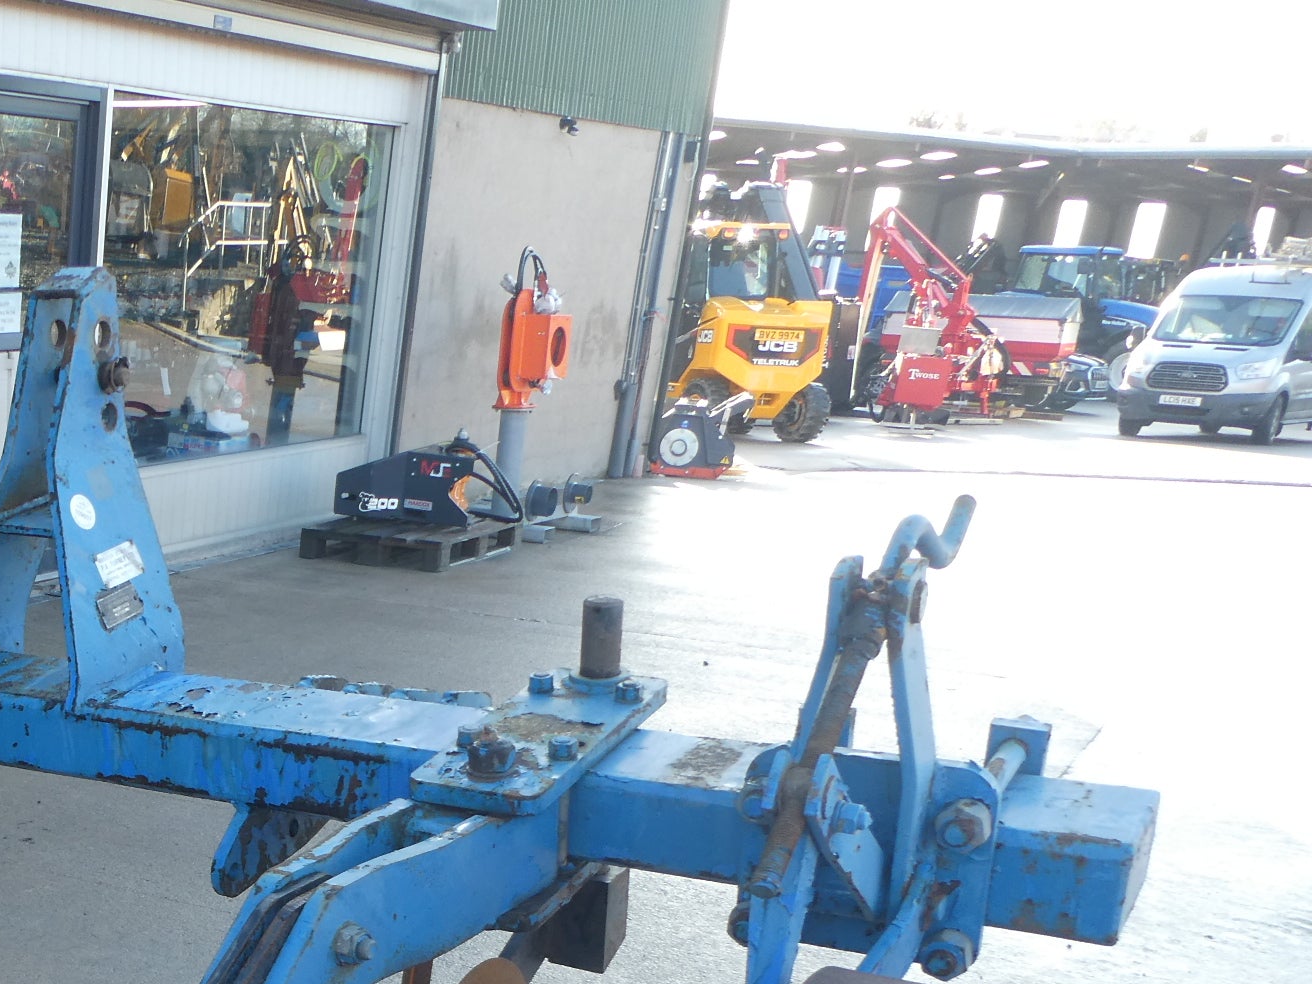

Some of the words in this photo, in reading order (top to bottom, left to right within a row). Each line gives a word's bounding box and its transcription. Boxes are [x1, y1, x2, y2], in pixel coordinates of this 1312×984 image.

[697, 329, 714, 343] JCB
[758, 330, 776, 339] BVZ
[778, 331, 800, 341] 9974
[757, 340, 798, 353] JCB
[751, 358, 799, 367] TELETRUK
